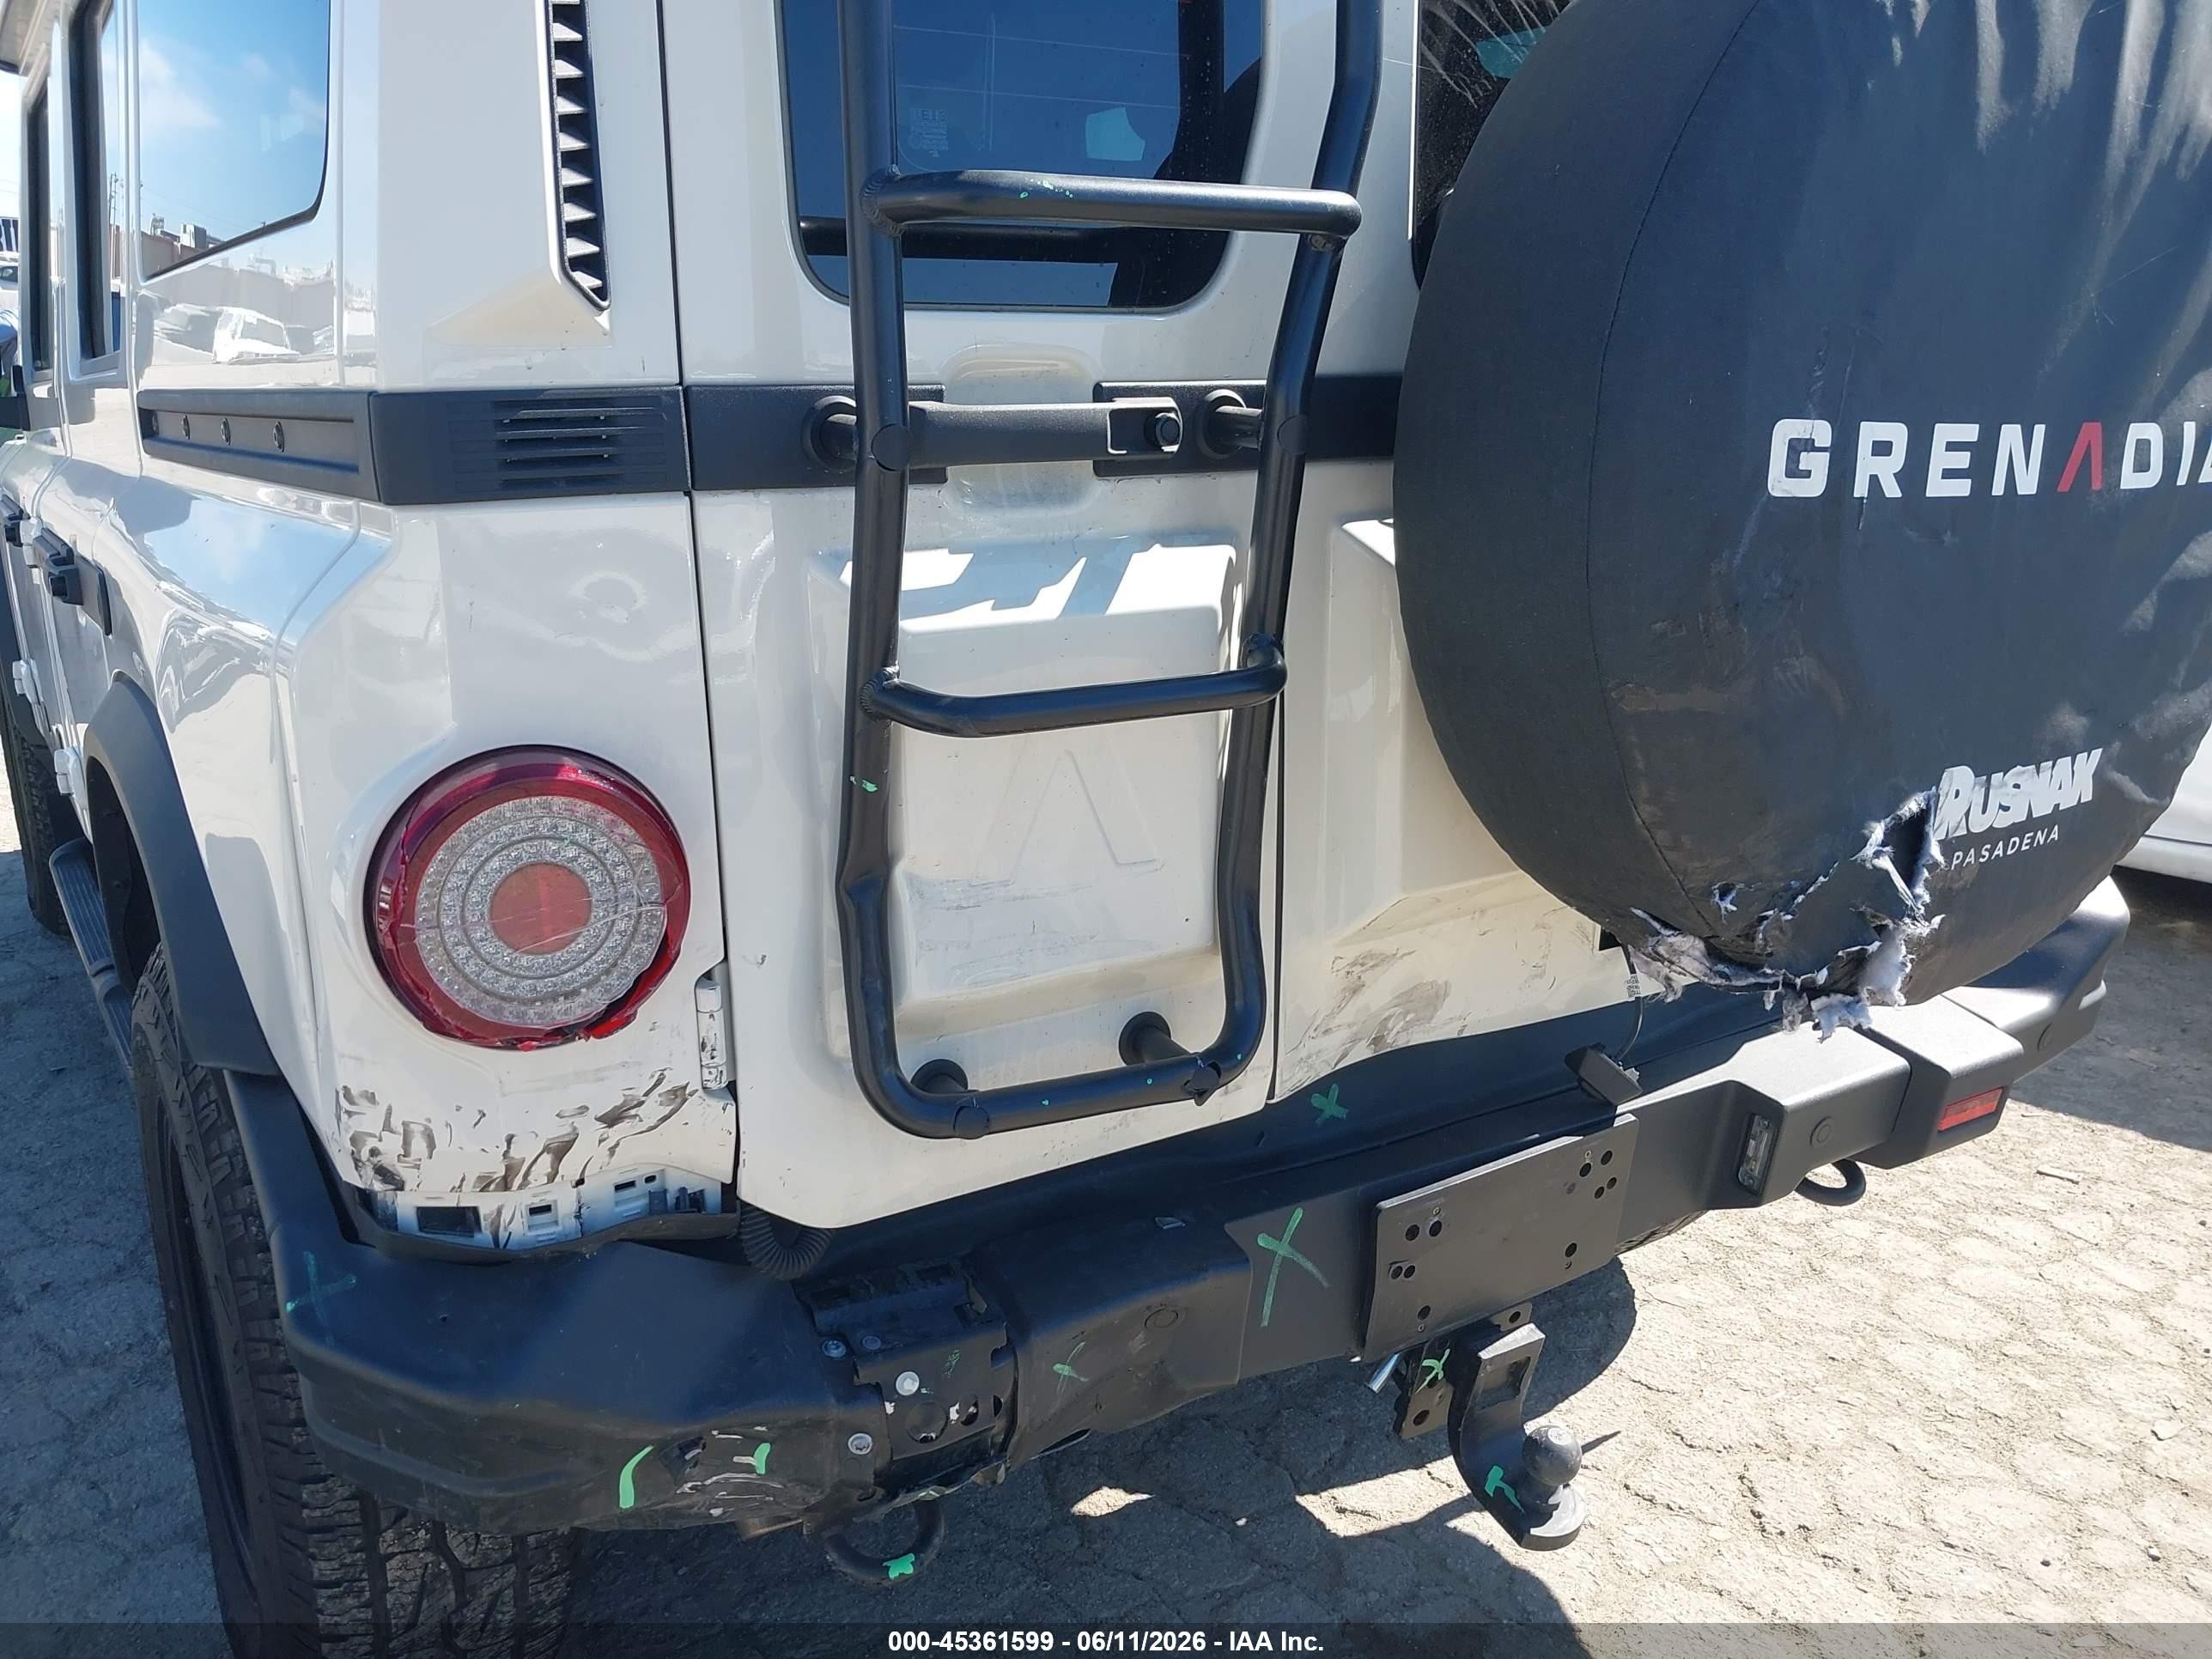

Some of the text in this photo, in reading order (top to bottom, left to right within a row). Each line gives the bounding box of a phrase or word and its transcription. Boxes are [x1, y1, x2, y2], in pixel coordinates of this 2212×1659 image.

[1767, 418, 2212, 497] GRENADI
[1932, 748, 2103, 841] RUSNAK
[1951, 824, 2059, 871] PASADENA
